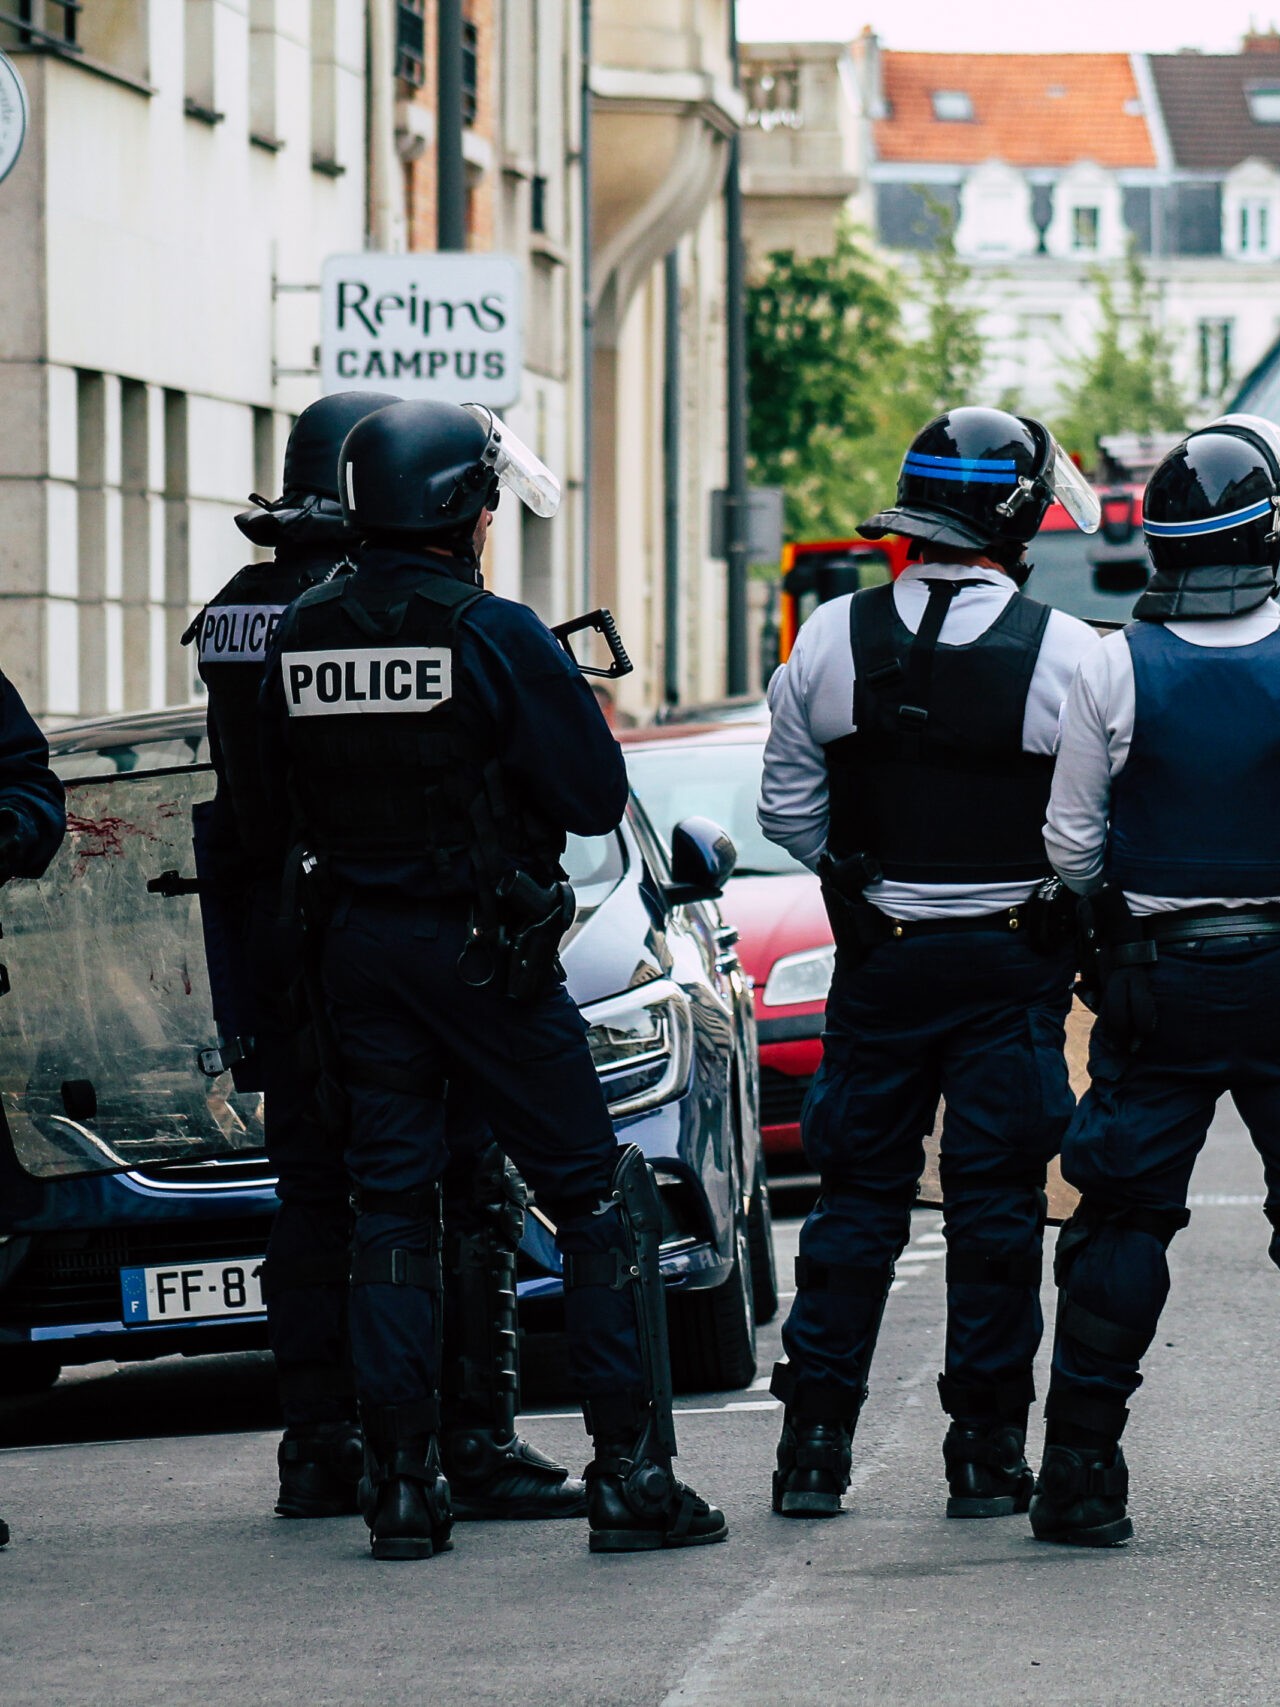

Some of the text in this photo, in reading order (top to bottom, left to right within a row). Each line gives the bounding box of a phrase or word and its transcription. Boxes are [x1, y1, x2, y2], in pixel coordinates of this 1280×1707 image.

[336, 280, 507, 338] Reims
[336, 348, 506, 380] CAMPUS
[289, 659, 443, 705] POLICE
